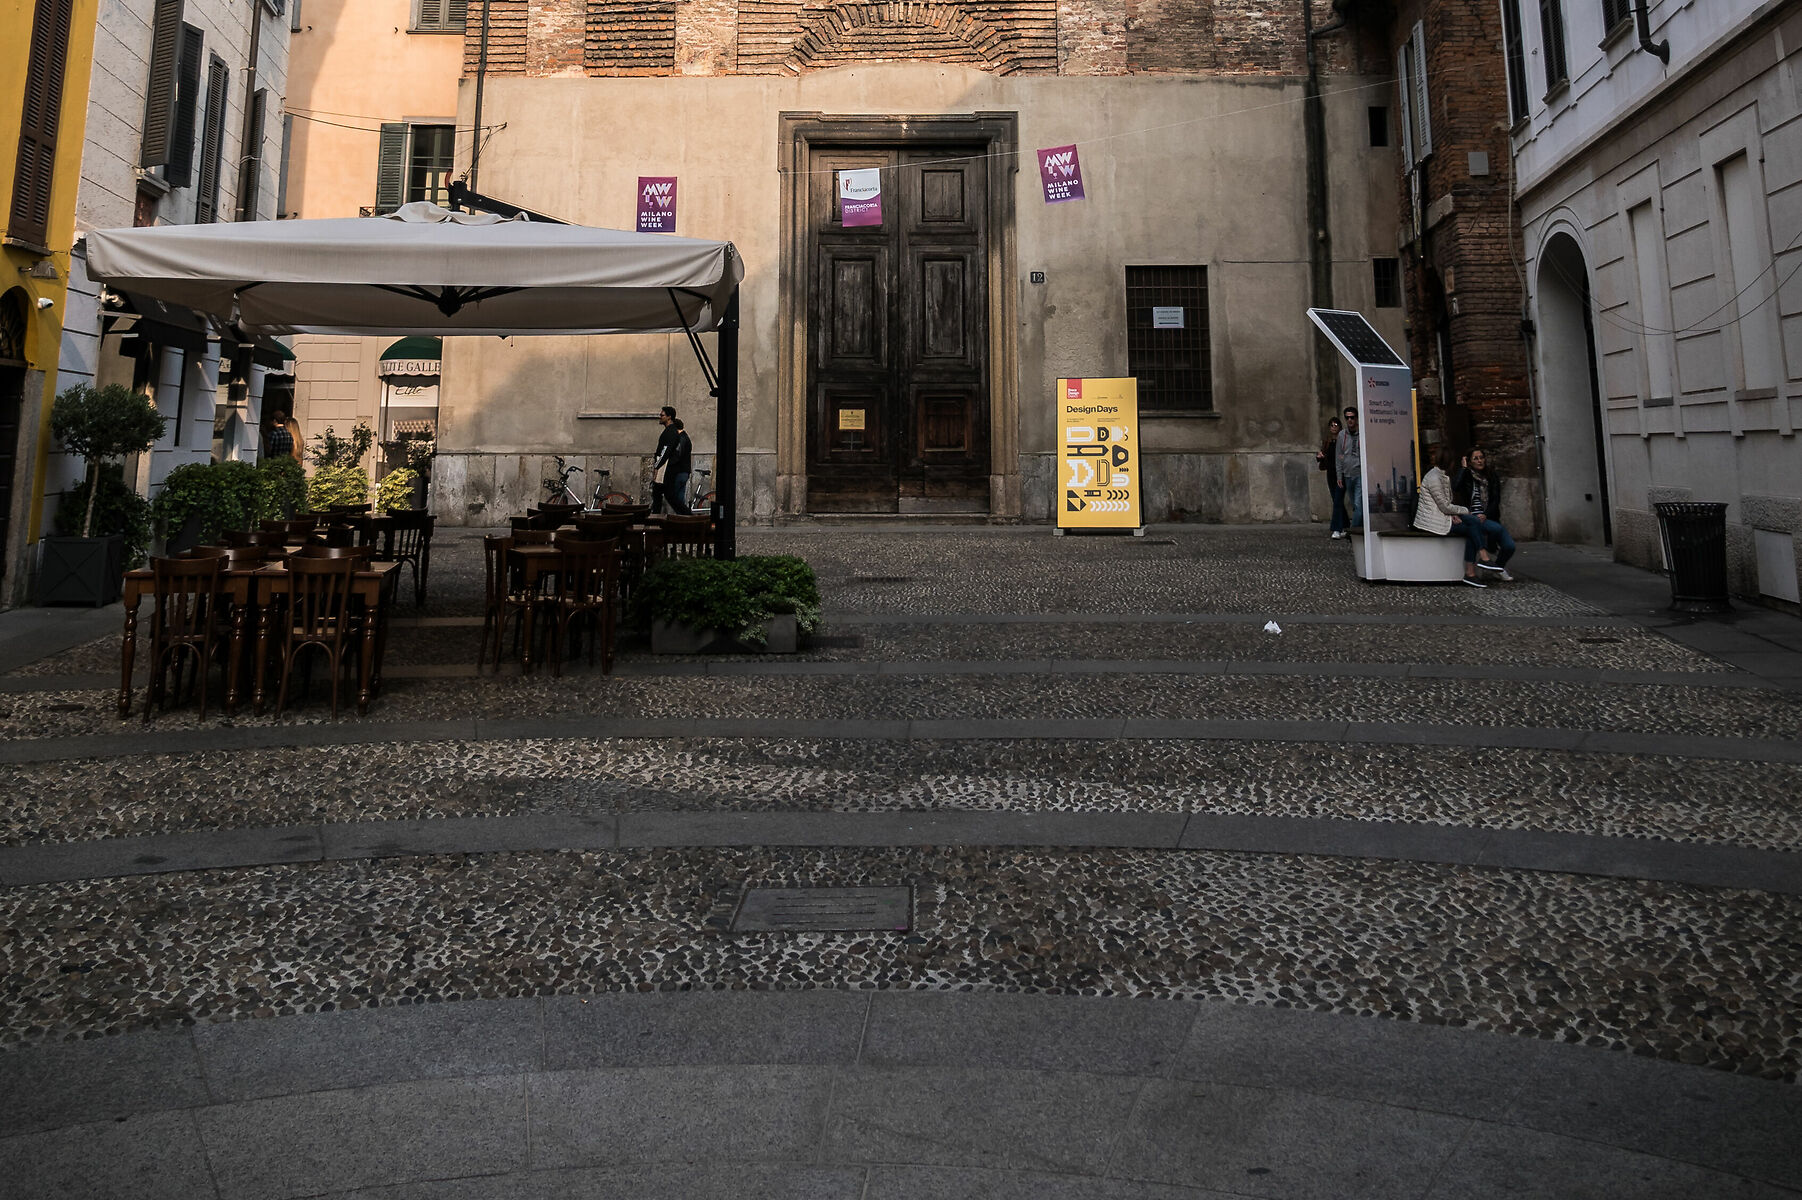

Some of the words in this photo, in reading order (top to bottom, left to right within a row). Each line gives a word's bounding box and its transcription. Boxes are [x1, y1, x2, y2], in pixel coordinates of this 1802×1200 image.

[1047, 179, 1079, 189] MILANO
[1047, 186, 1069, 194] WINE
[1048, 191, 1071, 200] WEEK
[1033, 272, 1043, 282] 12
